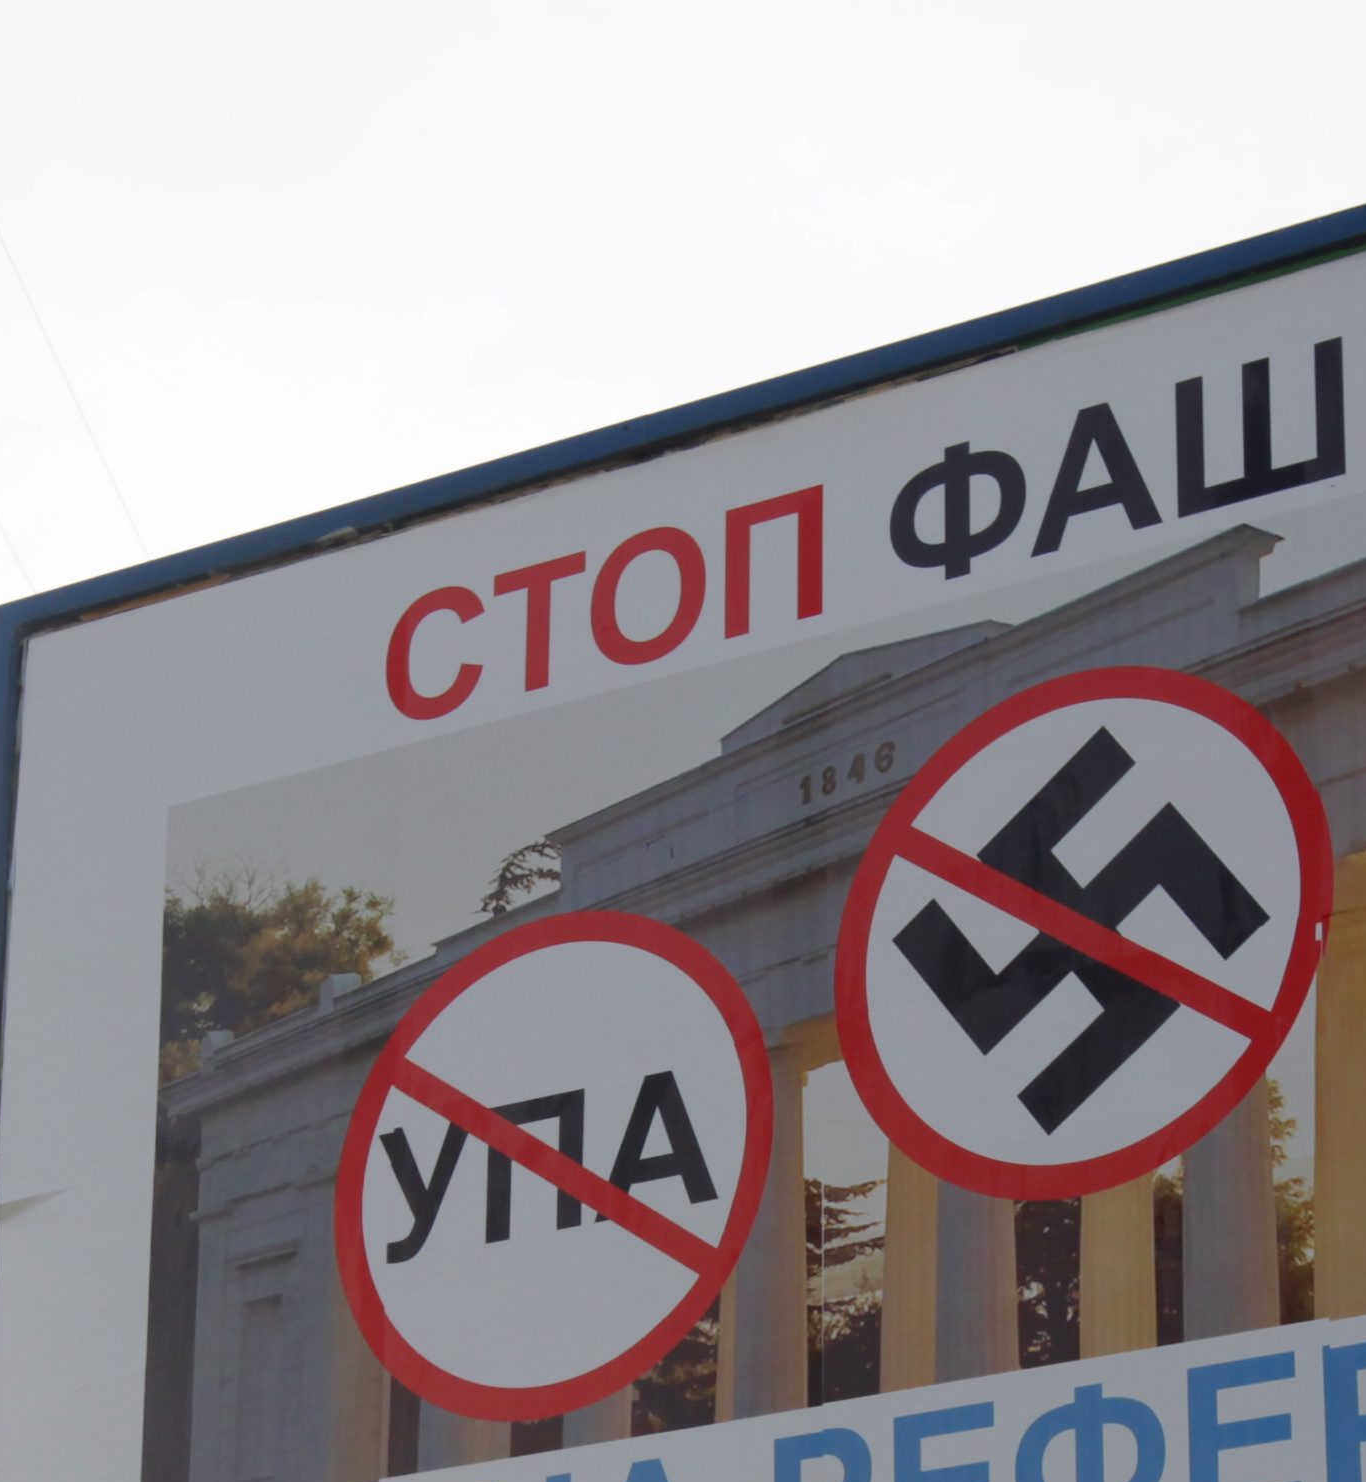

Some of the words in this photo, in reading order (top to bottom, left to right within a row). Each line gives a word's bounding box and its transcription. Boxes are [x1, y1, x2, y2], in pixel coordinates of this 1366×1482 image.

[385, 484, 824, 721] СТОП
[799, 741, 896, 805] 1846
[379, 1070, 718, 1264] УПА
